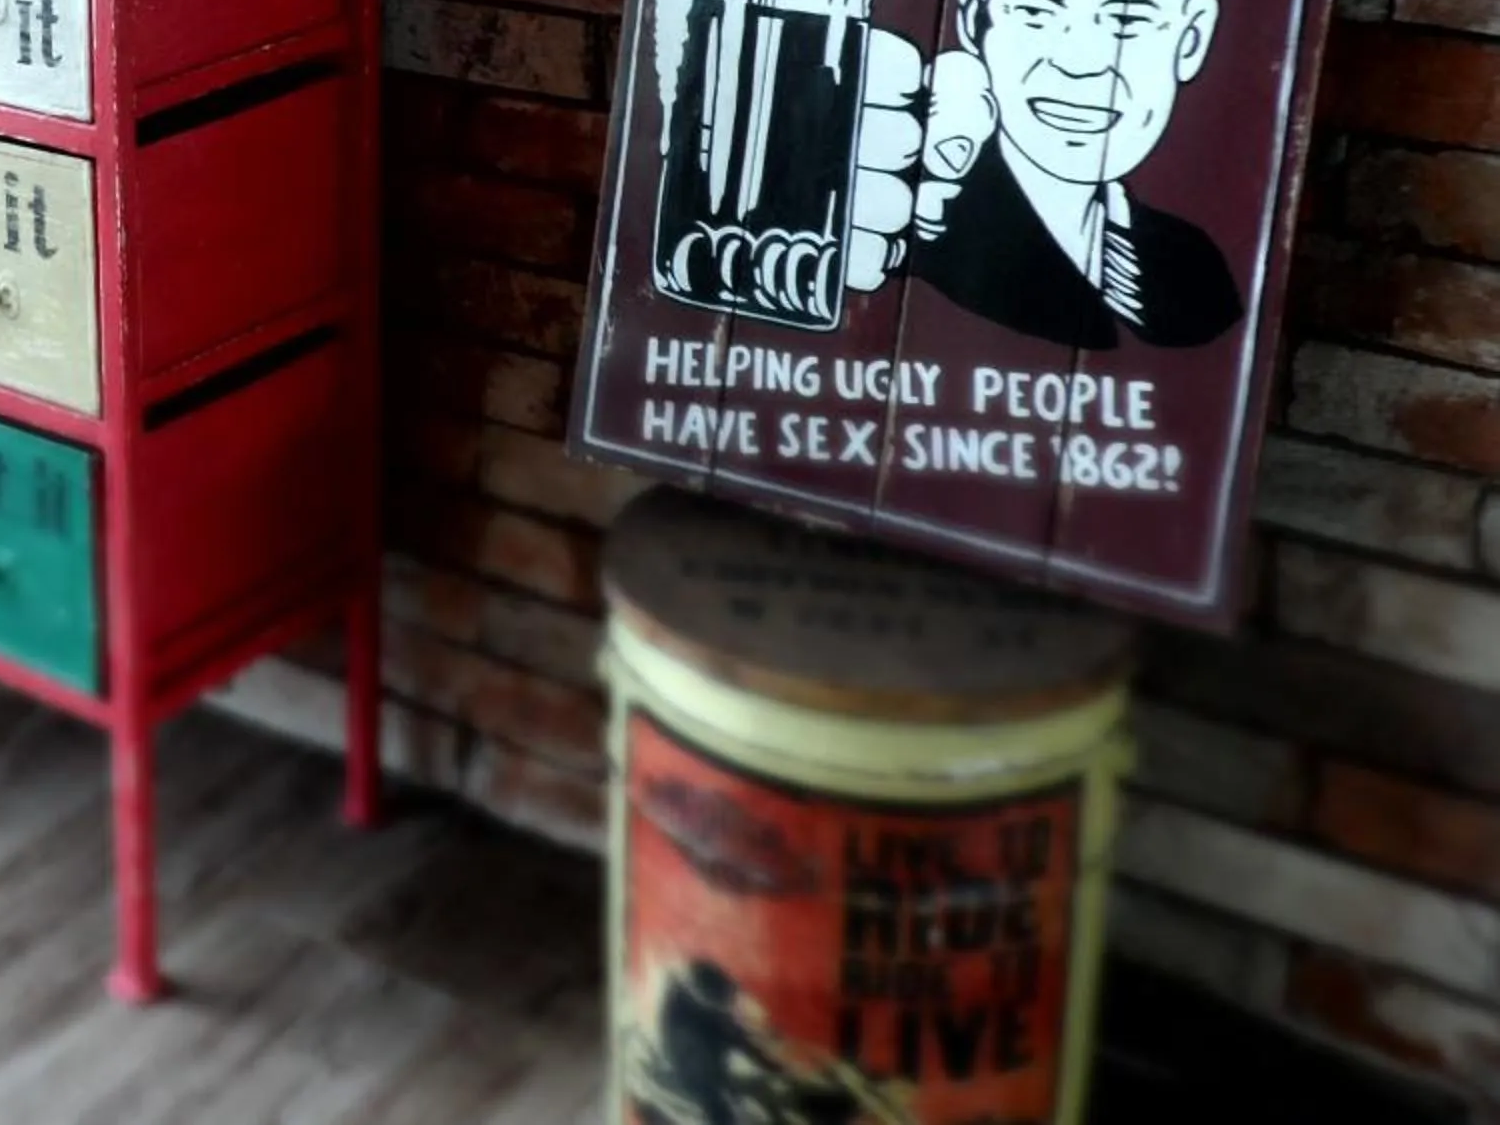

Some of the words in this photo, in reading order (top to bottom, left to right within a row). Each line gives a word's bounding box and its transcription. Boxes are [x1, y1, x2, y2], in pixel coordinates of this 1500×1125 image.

[3, 170, 59, 260] it
[646, 336, 821, 399] HELPING
[834, 358, 942, 407] UGLY
[972, 366, 1156, 431] PEOPLE
[642, 399, 760, 456] HAVE
[778, 413, 878, 467] SEX
[903, 423, 1036, 479] SINCE
[32, 456, 73, 539] it
